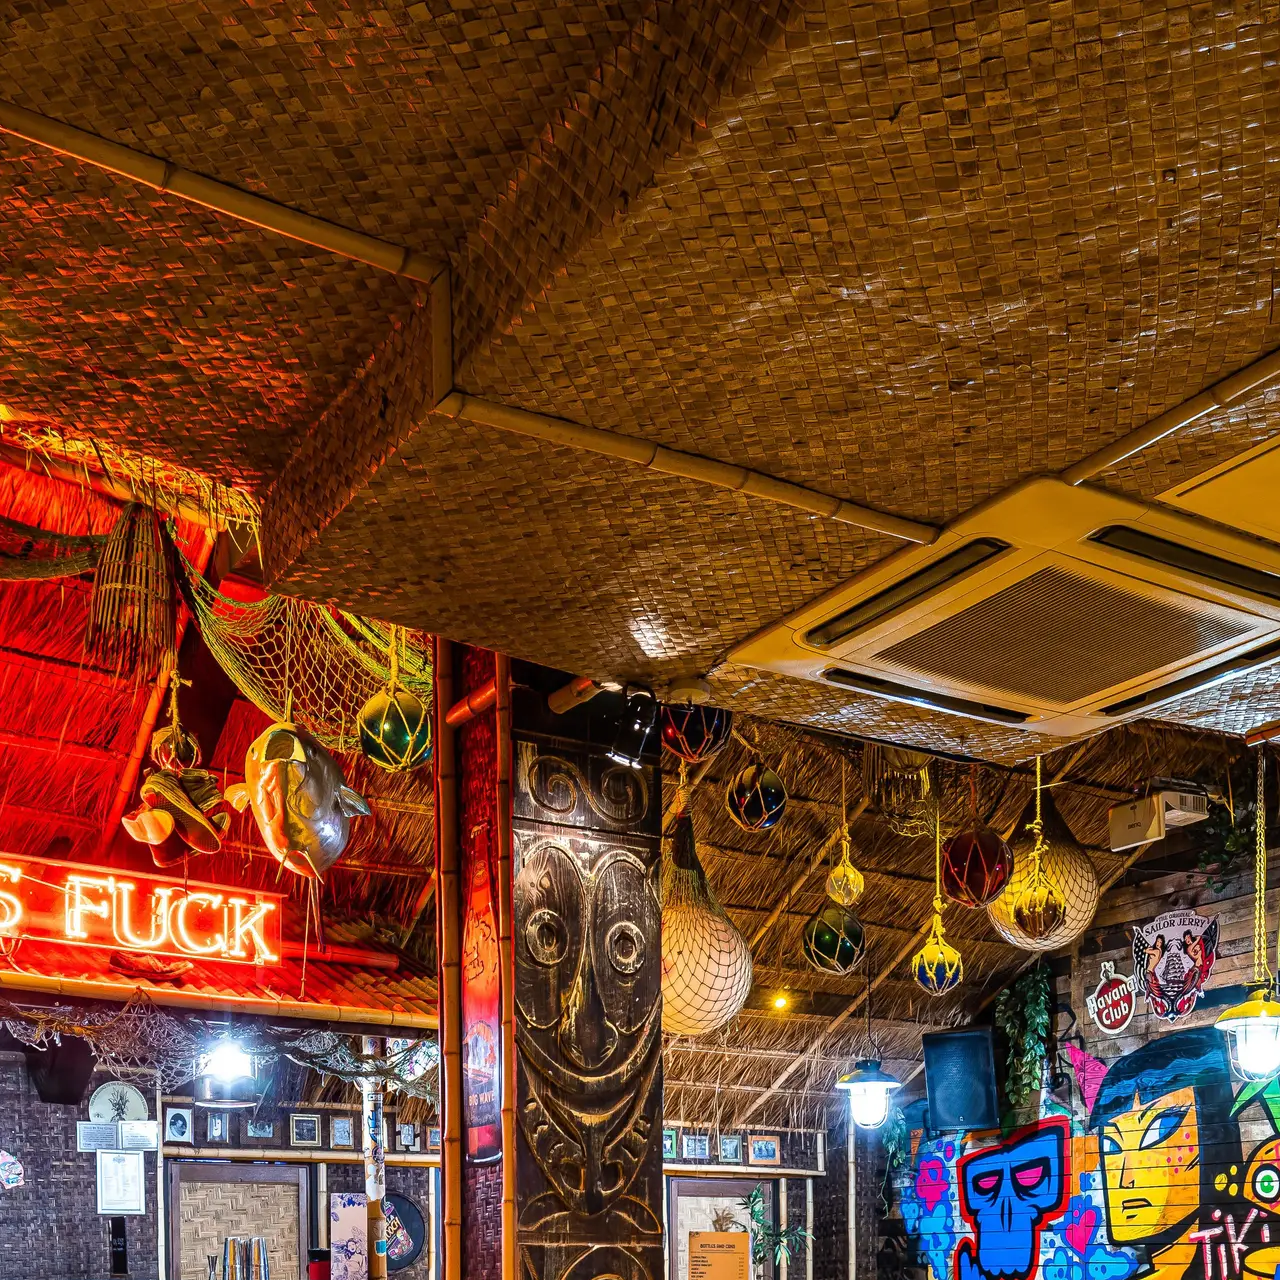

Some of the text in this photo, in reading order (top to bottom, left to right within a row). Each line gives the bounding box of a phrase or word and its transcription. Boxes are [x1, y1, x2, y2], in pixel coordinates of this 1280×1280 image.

[64, 872, 280, 965] FUCK
[1144, 917, 1206, 937] SAILOR JERRY
[1087, 976, 1138, 1015] Havana
[1102, 1000, 1130, 1025] Club
[468, 1091, 495, 1106] BIG WAVE
